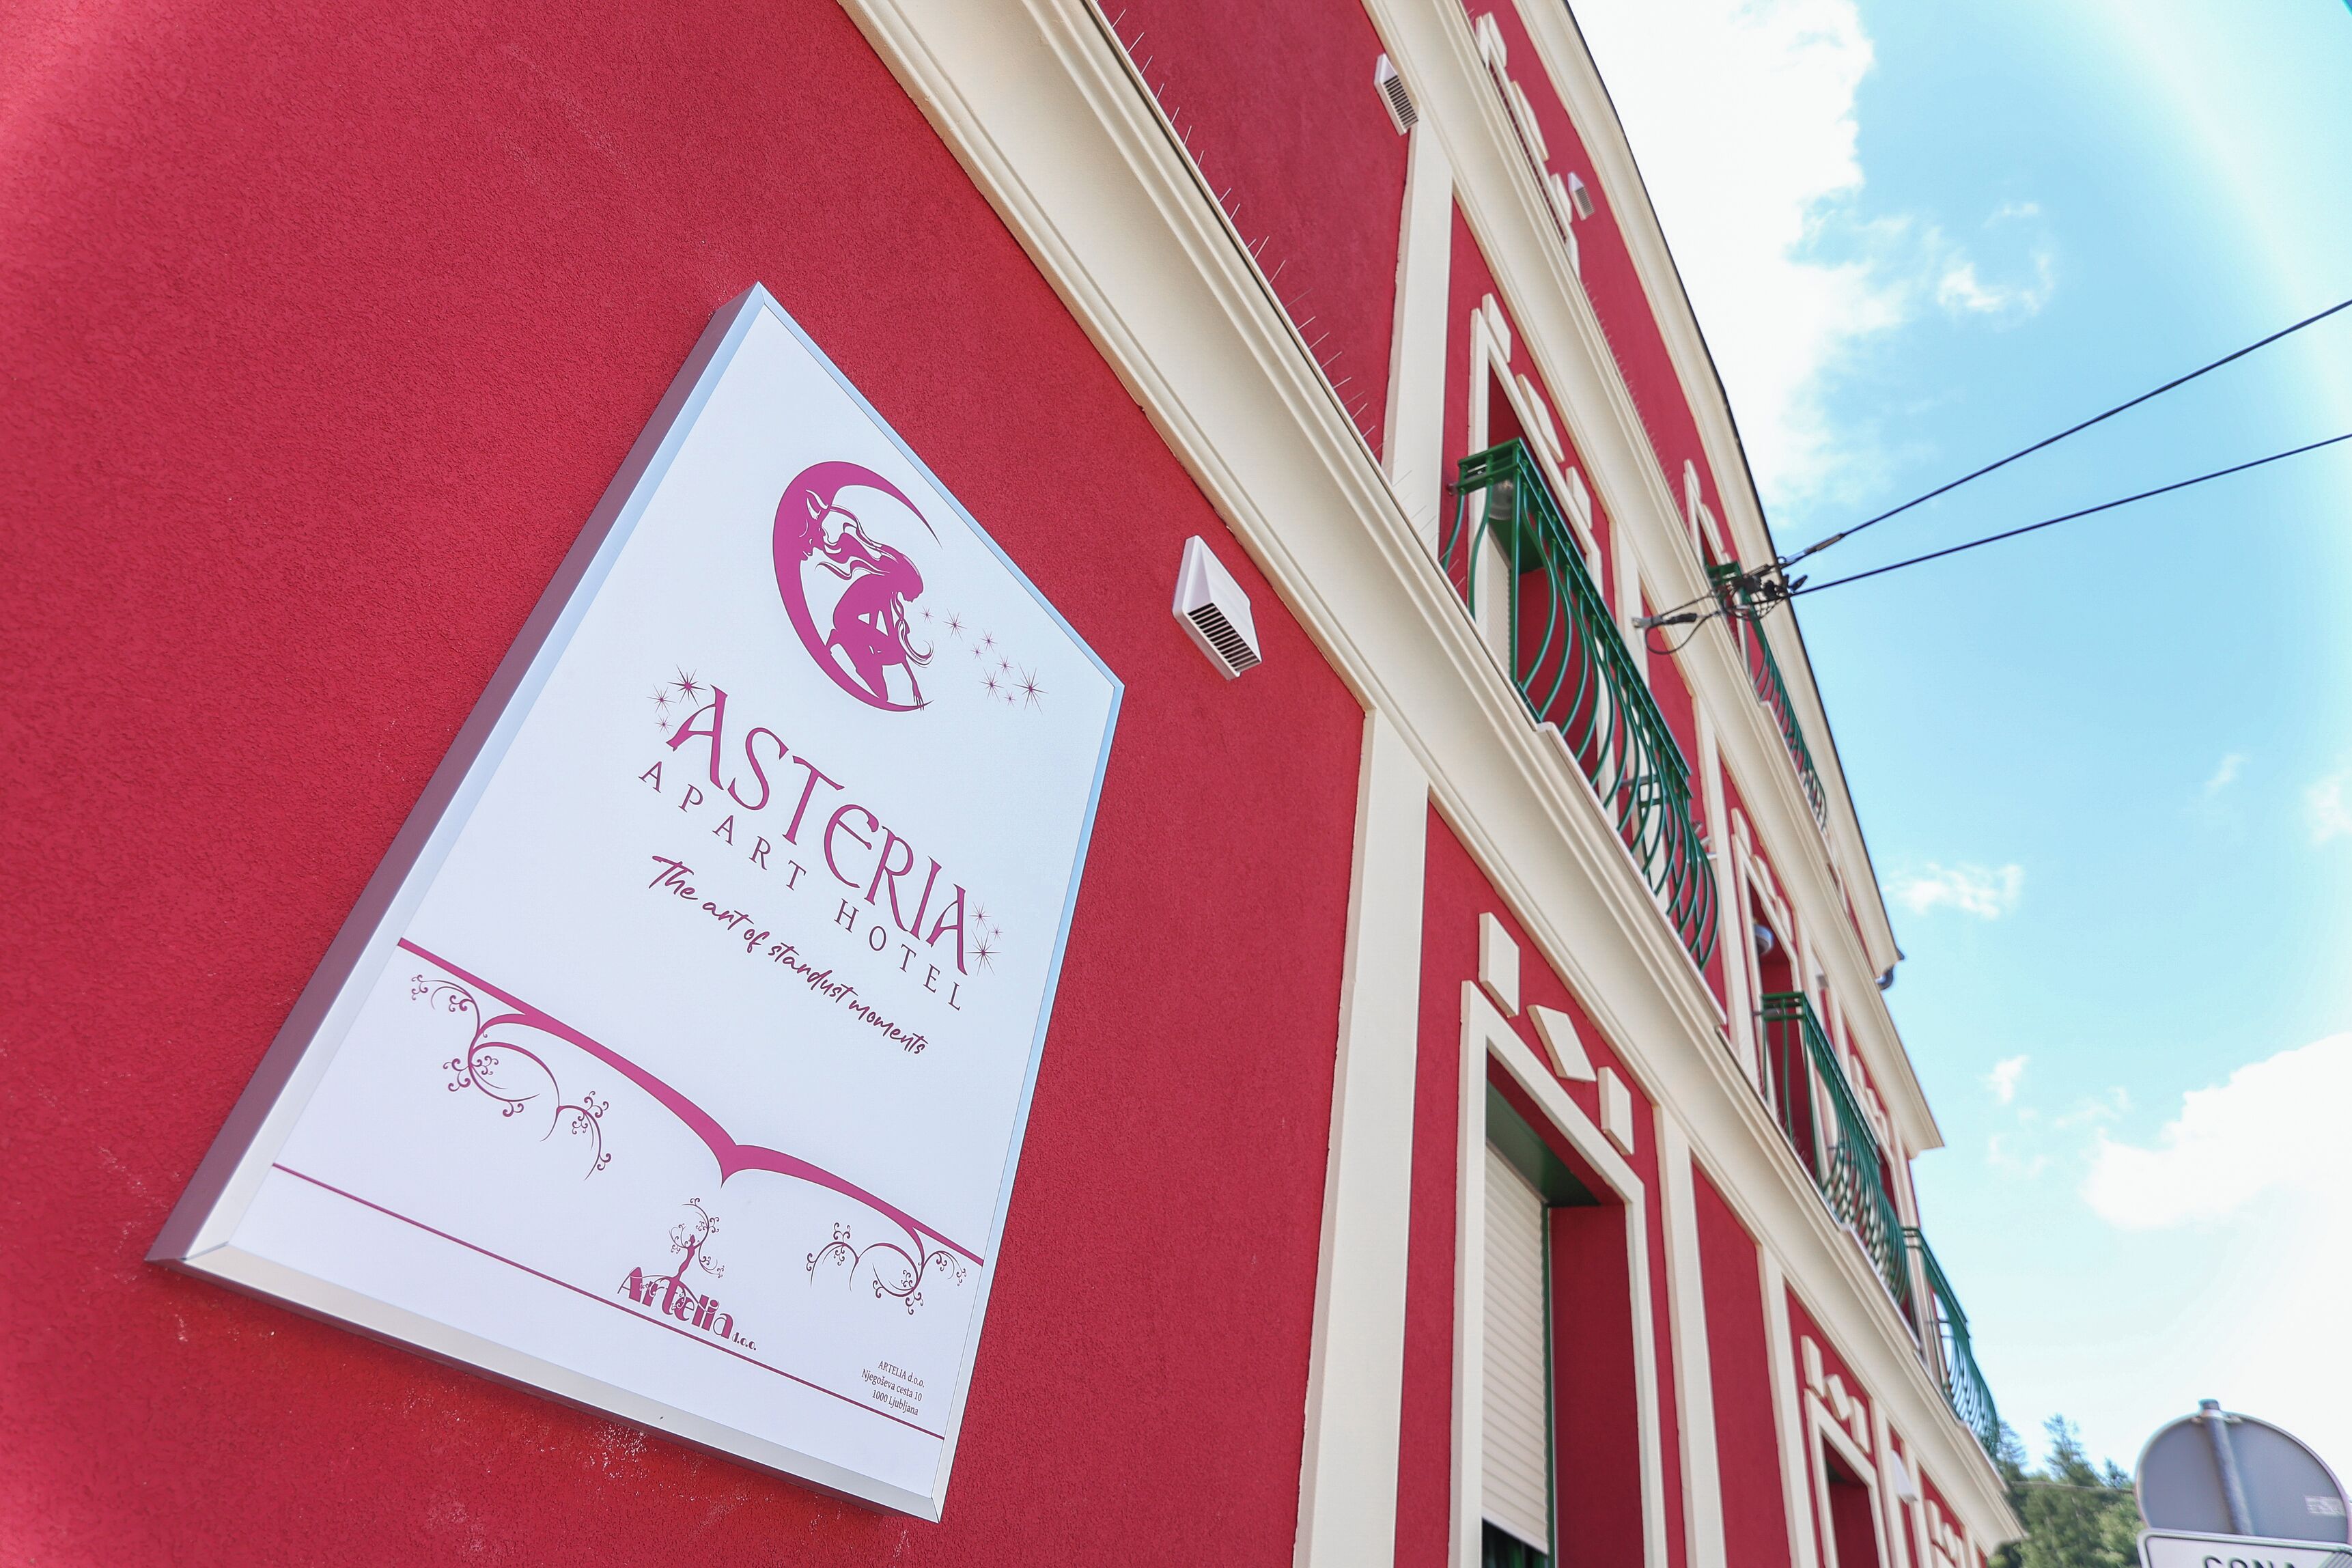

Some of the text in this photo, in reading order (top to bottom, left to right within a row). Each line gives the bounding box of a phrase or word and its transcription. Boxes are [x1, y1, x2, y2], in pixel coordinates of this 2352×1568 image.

[666, 684, 968, 976] ASTERIA
[638, 761, 962, 1011] APART HOTEL
[649, 855, 929, 1055] The art of stardust moments
[617, 1266, 757, 1352] Artelia d.o.o.
[861, 1368, 923, 1401] Njegoševa cesta 10
[871, 1389, 919, 1416] 1000 Ljubljana
[878, 1360, 925, 1388] ARTELIA d.o.o.
